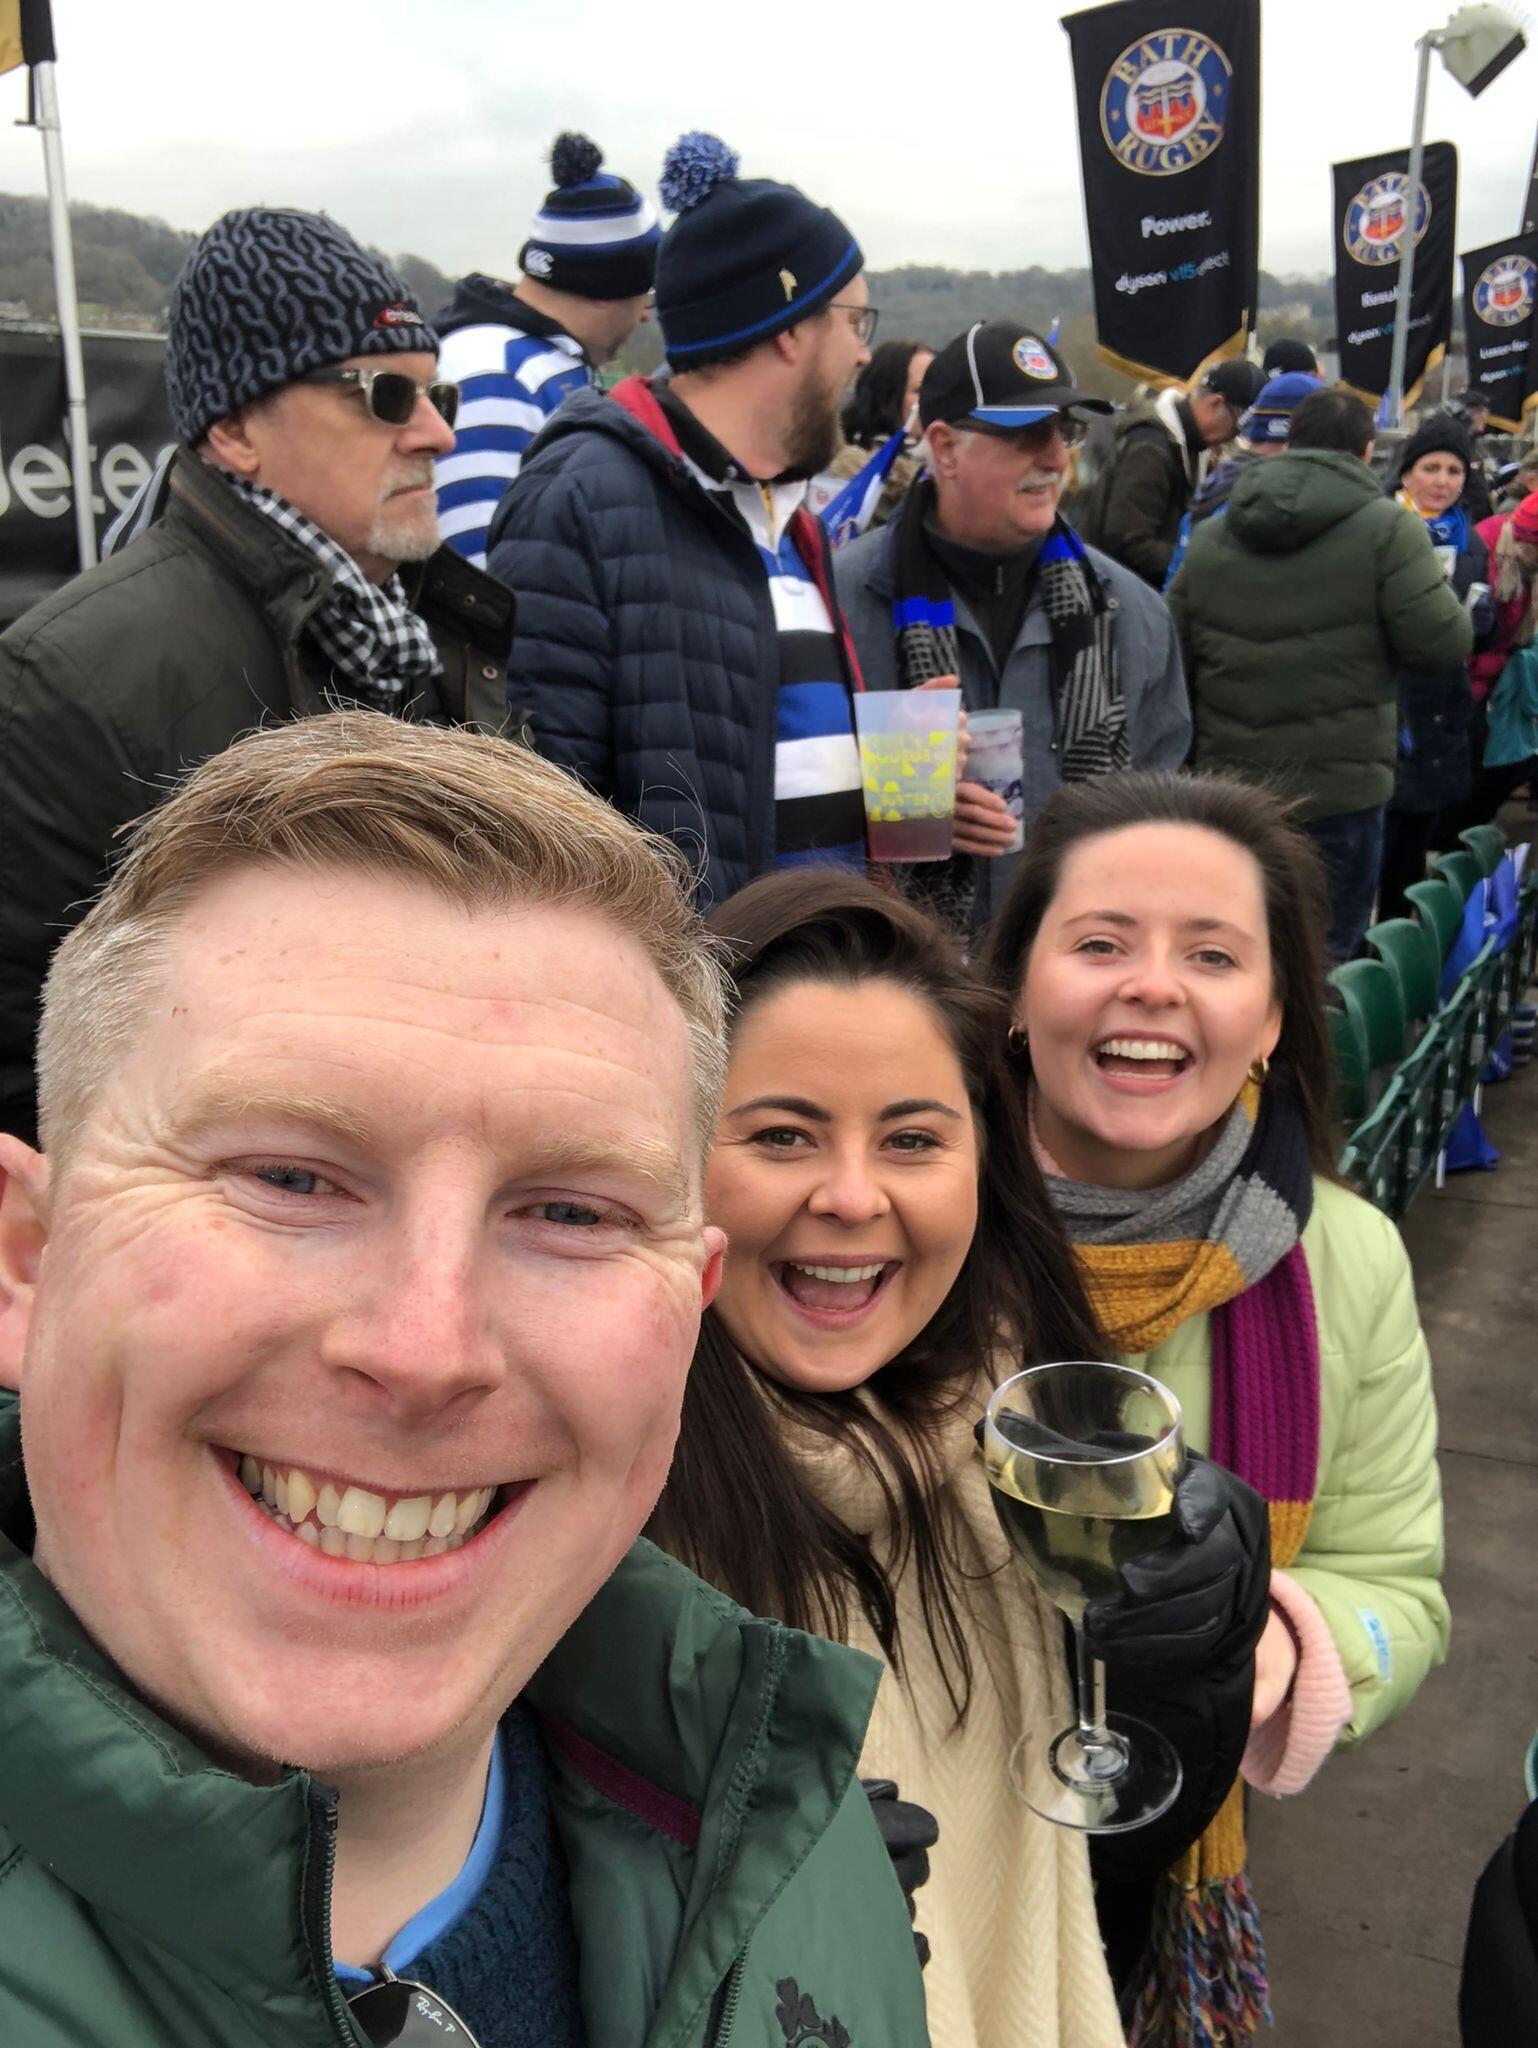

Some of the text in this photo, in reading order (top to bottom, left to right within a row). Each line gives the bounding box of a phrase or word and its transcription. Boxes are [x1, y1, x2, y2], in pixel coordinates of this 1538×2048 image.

[1113, 33, 1213, 85] BATH
[1116, 108, 1224, 170] RUGBY
[1115, 272, 1167, 295] dyson
